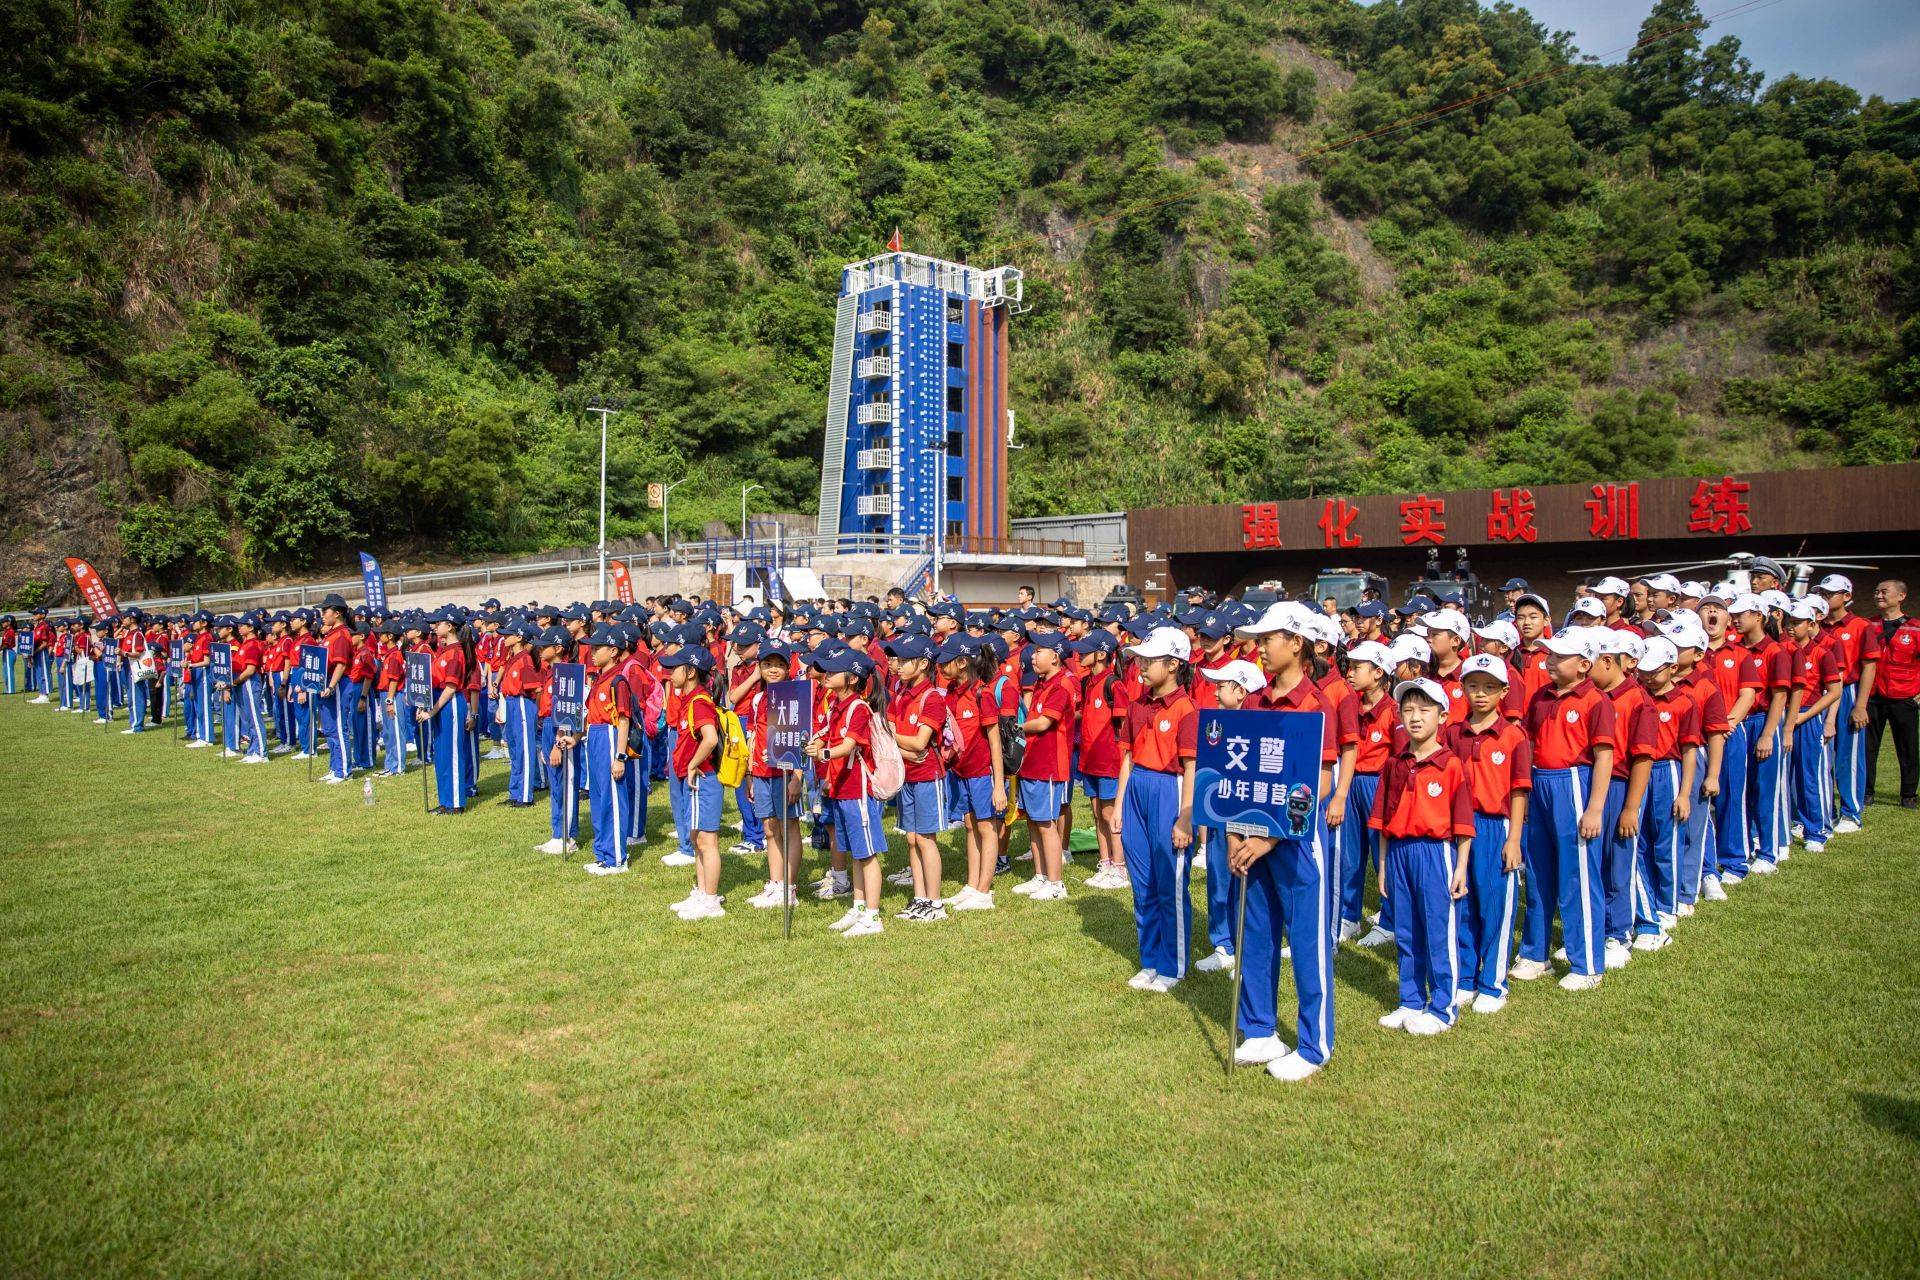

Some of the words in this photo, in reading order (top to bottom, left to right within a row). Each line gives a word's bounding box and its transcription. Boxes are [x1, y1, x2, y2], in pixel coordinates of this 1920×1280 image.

[1242, 475, 1753, 550] 强化实战训练
[1145, 551, 1157, 560] 5m
[1145, 579, 1157, 588] 3m
[305, 654, 320, 671] 南山
[559, 676, 575, 697] 坪山
[777, 699, 799, 726] 大鹏
[774, 730, 800, 747] 少年警营
[1225, 735, 1286, 774] 交警
[1217, 778, 1288, 806] 少年警营
